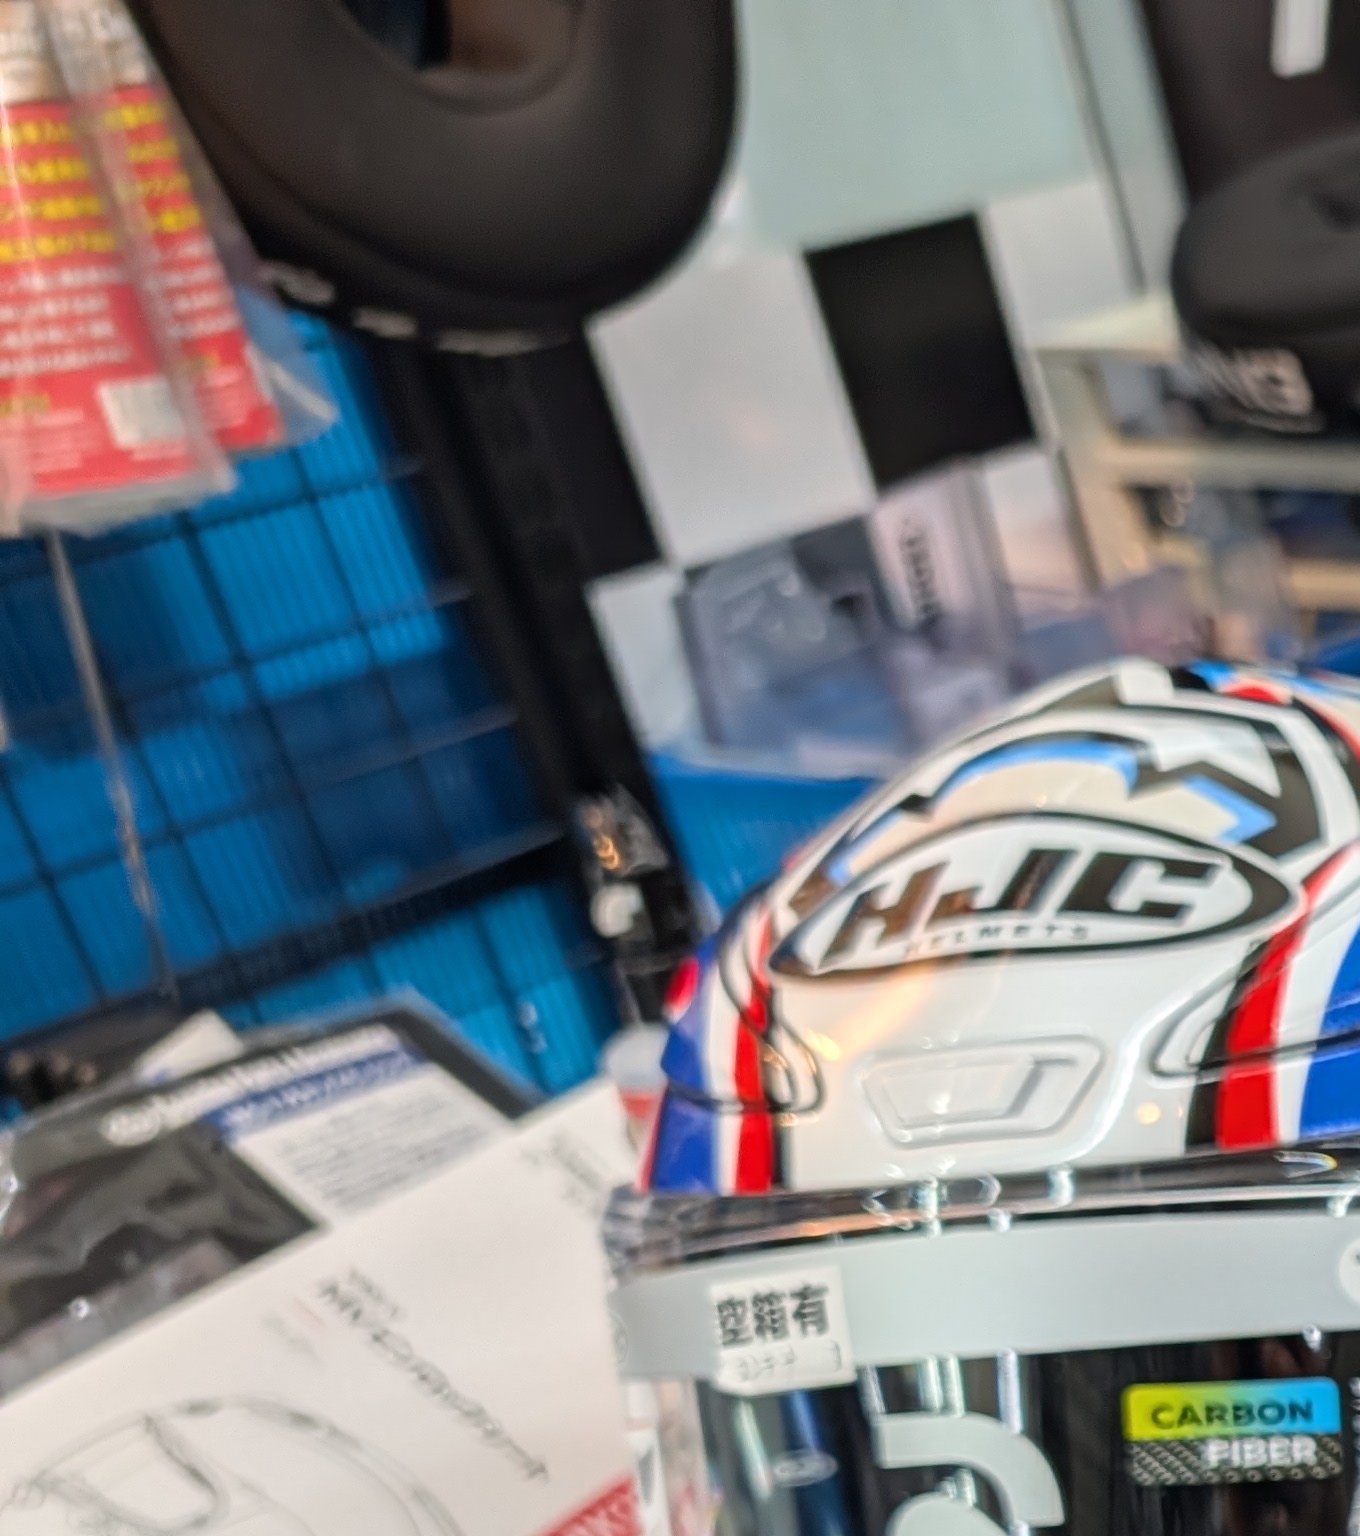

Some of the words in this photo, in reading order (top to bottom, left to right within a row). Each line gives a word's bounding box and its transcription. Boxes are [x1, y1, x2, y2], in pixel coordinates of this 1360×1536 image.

[819, 847, 1228, 972] HJC
[1151, 1400, 1314, 1430] CARBON
[1206, 1434, 1318, 1468] FIBER
